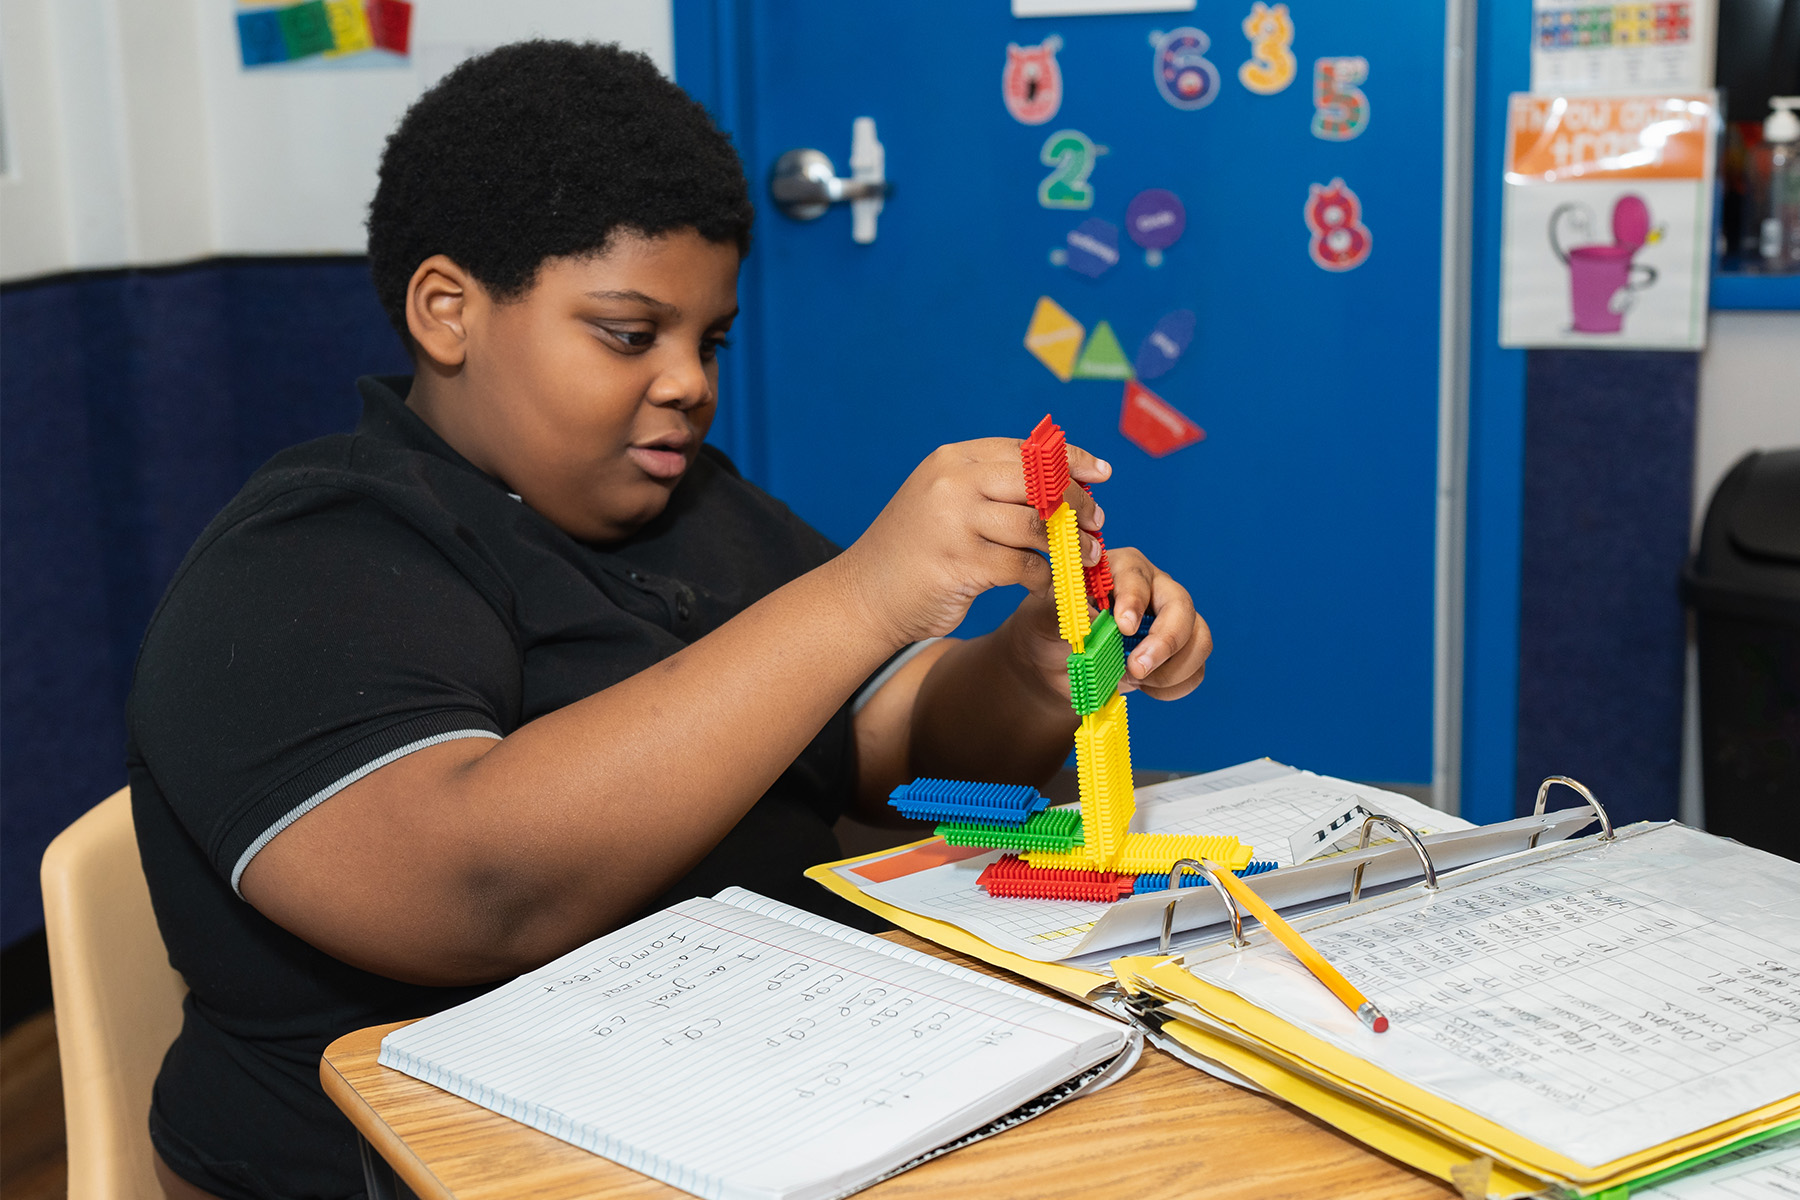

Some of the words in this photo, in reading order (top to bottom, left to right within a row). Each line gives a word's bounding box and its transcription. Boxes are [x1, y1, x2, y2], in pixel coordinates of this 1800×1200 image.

[1155, 28, 1220, 110] 6
[1239, 4, 1297, 94] 3
[1312, 57, 1369, 140] 5
[1040, 130, 1094, 209] 2
[1305, 183, 1372, 271] 8
[667, 931, 686, 943] I
[694, 942, 720, 953] I
[737, 952, 760, 963] I
